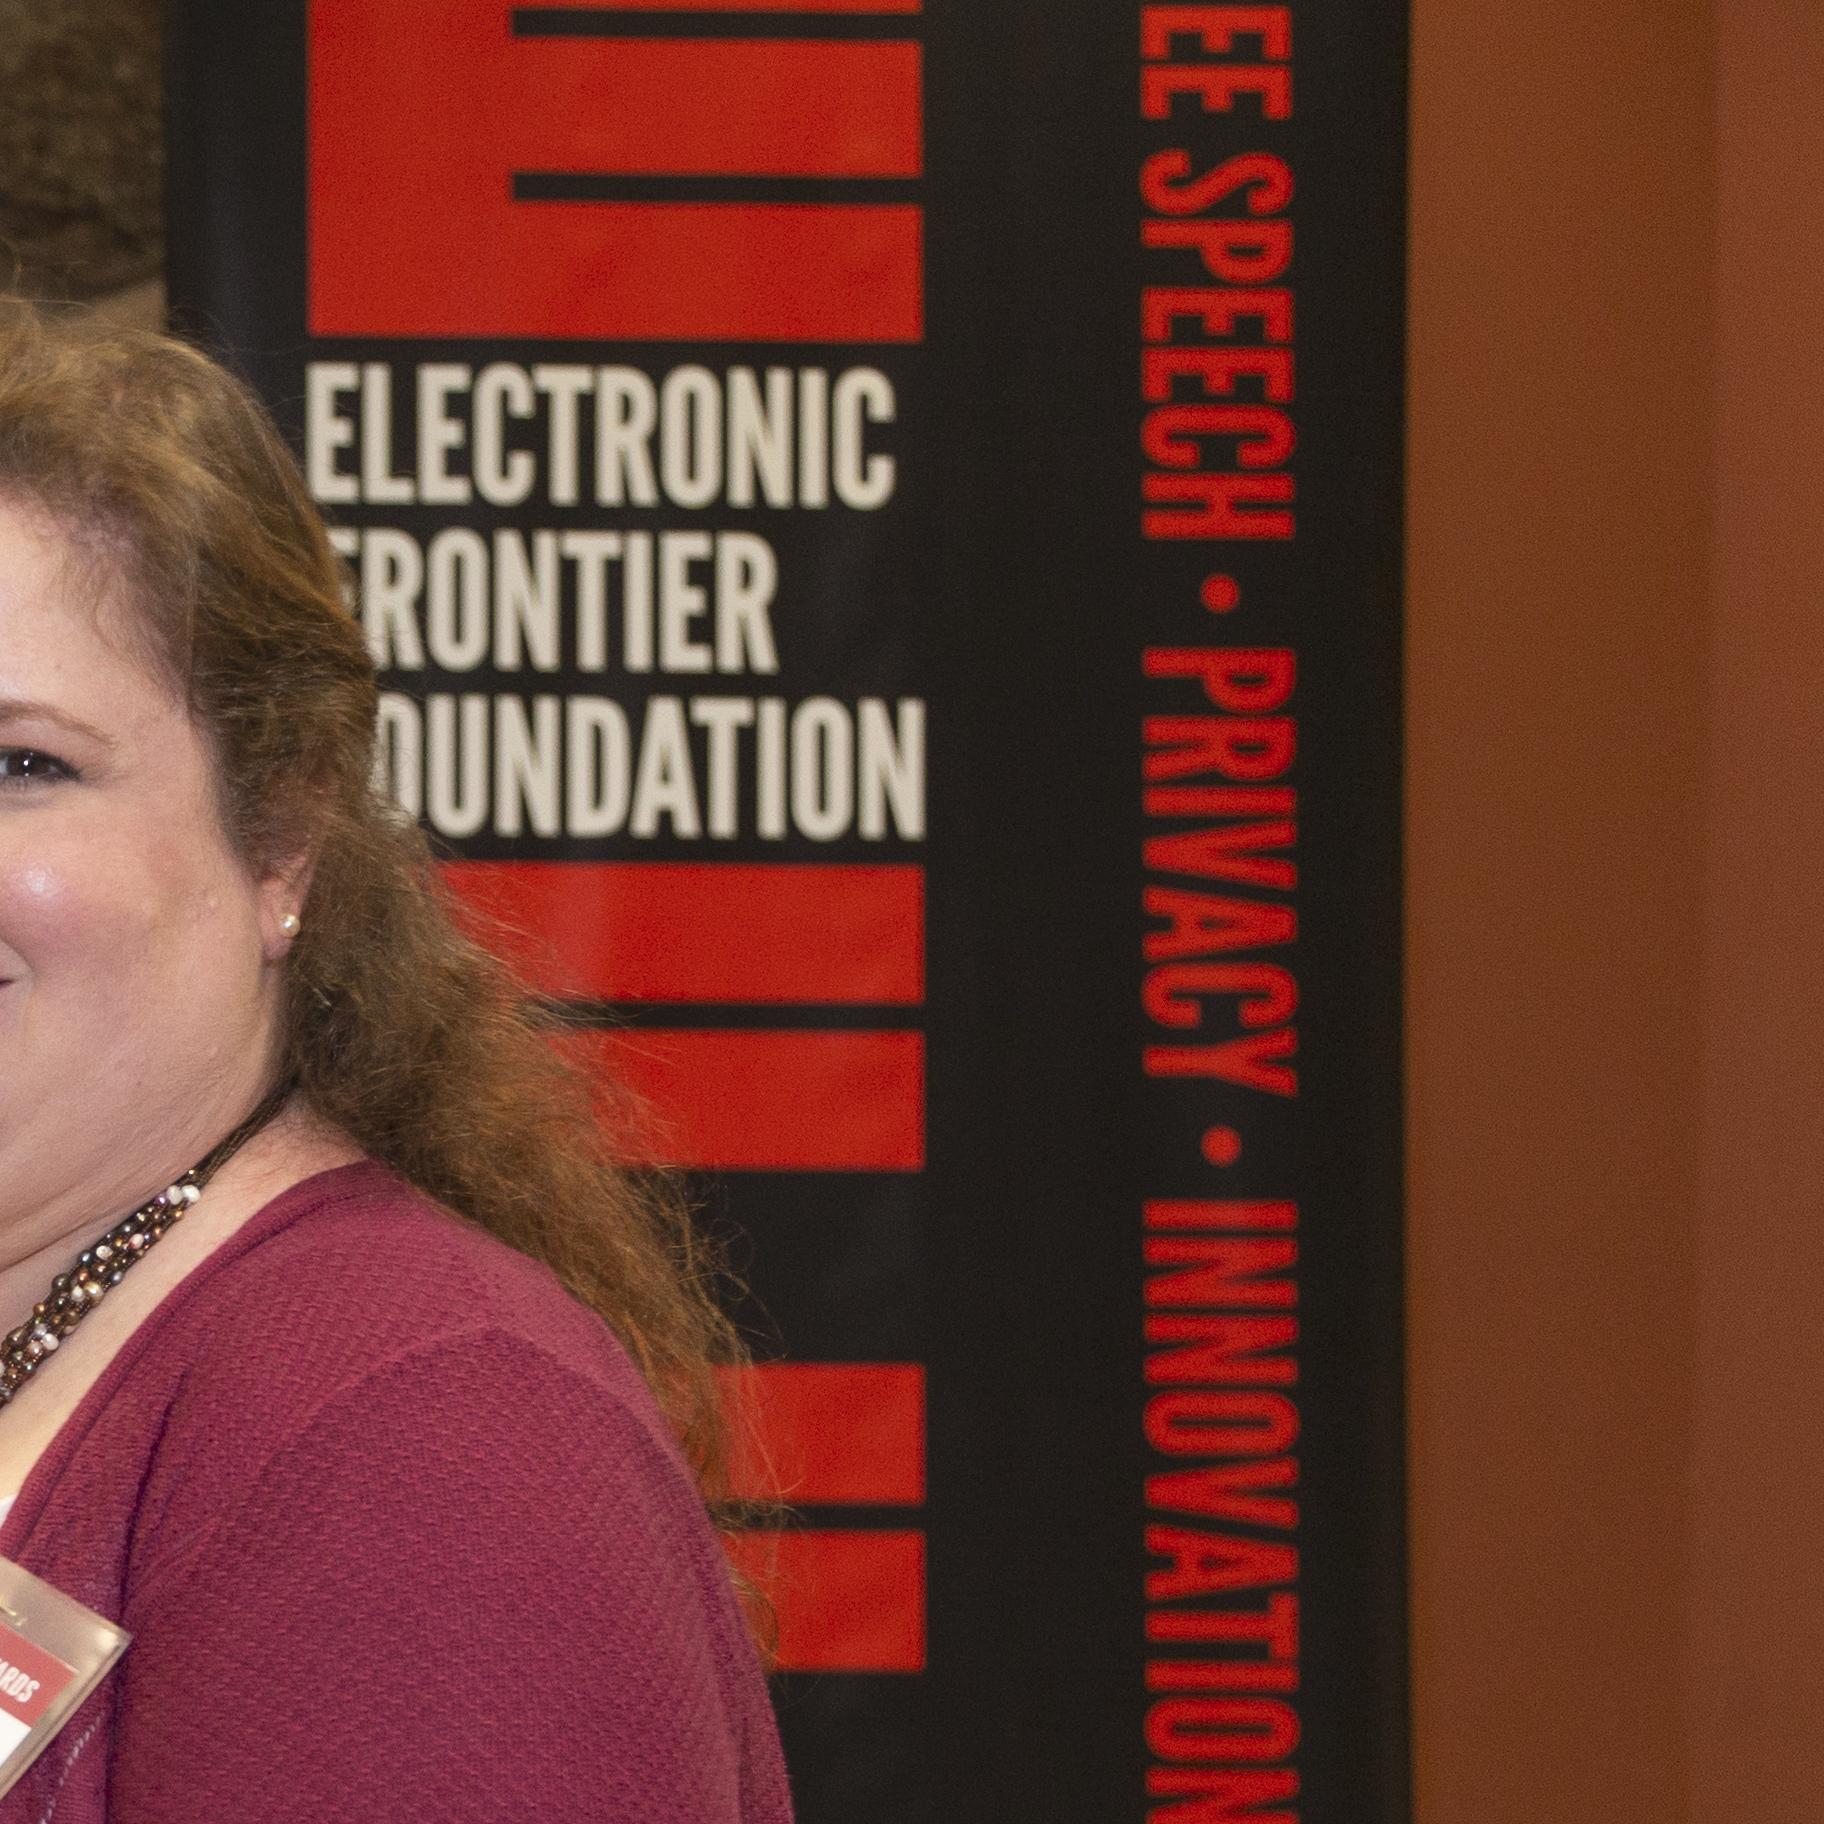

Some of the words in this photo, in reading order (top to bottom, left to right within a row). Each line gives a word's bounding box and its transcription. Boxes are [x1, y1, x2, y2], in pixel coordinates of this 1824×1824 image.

[305, 361, 897, 511] ELECTRONIC
[1140, 149, 1296, 540] SPEECH
[366, 693, 928, 843] OUNDATION
[1142, 647, 1298, 1099] PRIVACY
